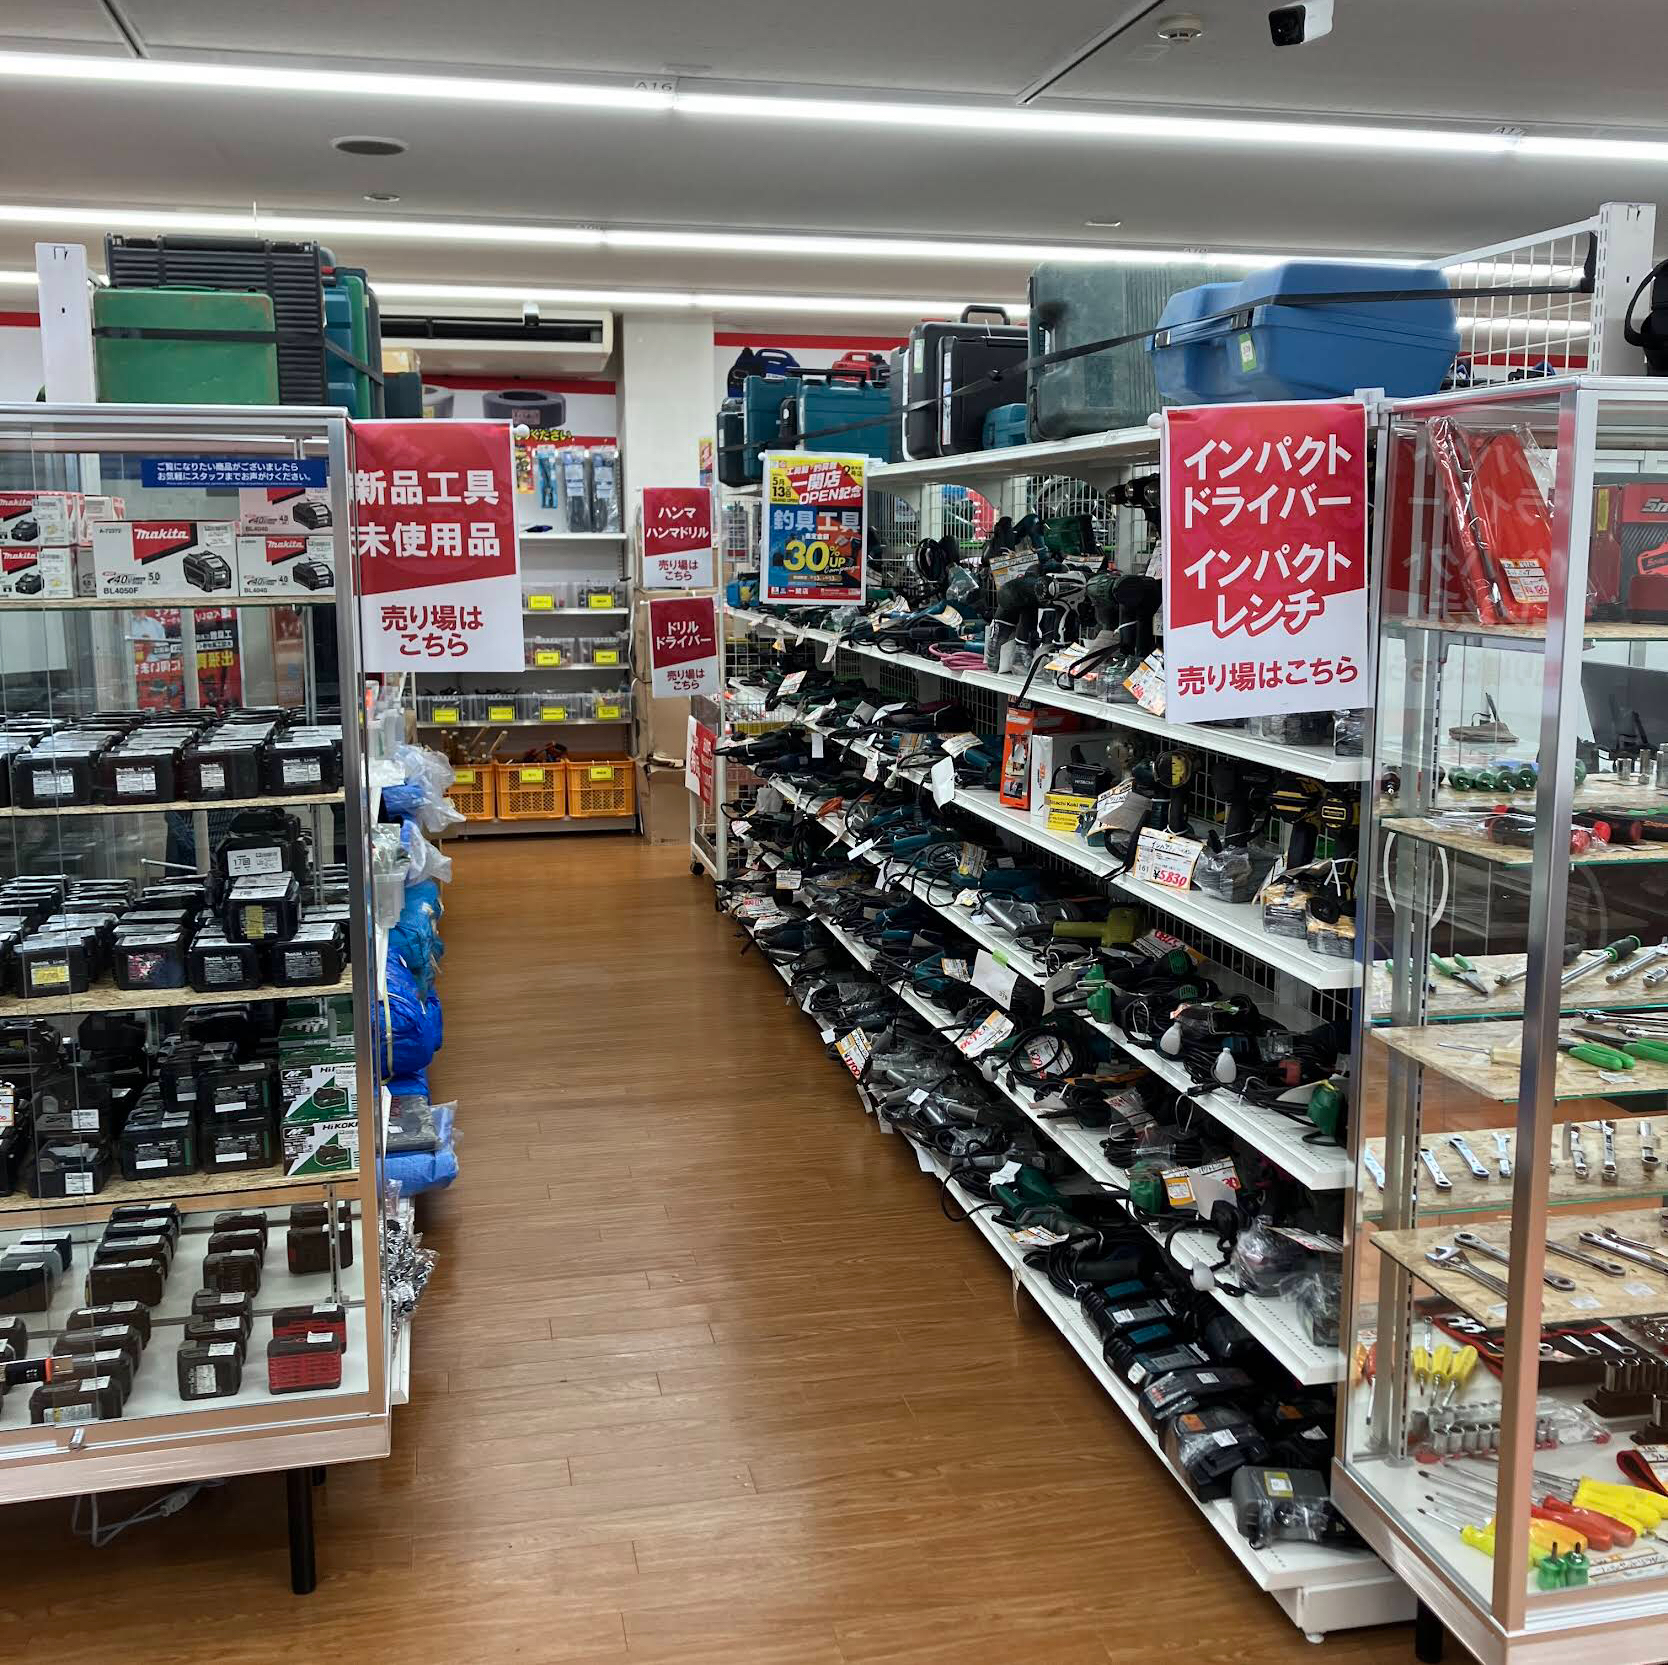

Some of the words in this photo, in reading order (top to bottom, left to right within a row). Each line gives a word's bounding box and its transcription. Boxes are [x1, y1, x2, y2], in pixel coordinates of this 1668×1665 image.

[1184, 434, 1352, 480] インパクト
[349, 470, 499, 505] 新品工具
[658, 507, 697, 519] ハンマ
[1185, 483, 1351, 528] ドライバー
[646, 526, 709, 539] ハンマドリル
[817, 511, 860, 532] 工具
[351, 522, 500, 557] 未使用品
[658, 560, 698, 570] 売り場は
[783, 541, 829, 571] 30
[829, 557, 846, 567] UP
[1184, 541, 1352, 589] インパクト
[665, 571, 692, 581] こちら
[380, 605, 484, 631] 売り場は
[1216, 588, 1321, 634] レンチ
[667, 621, 699, 635] ドリル
[399, 633, 469, 657] こちら
[656, 634, 712, 650] ドライバー
[667, 669, 705, 681] 売り場は
[673, 680, 700, 690] こちら
[1177, 656, 1358, 696] 売り場はこちら
